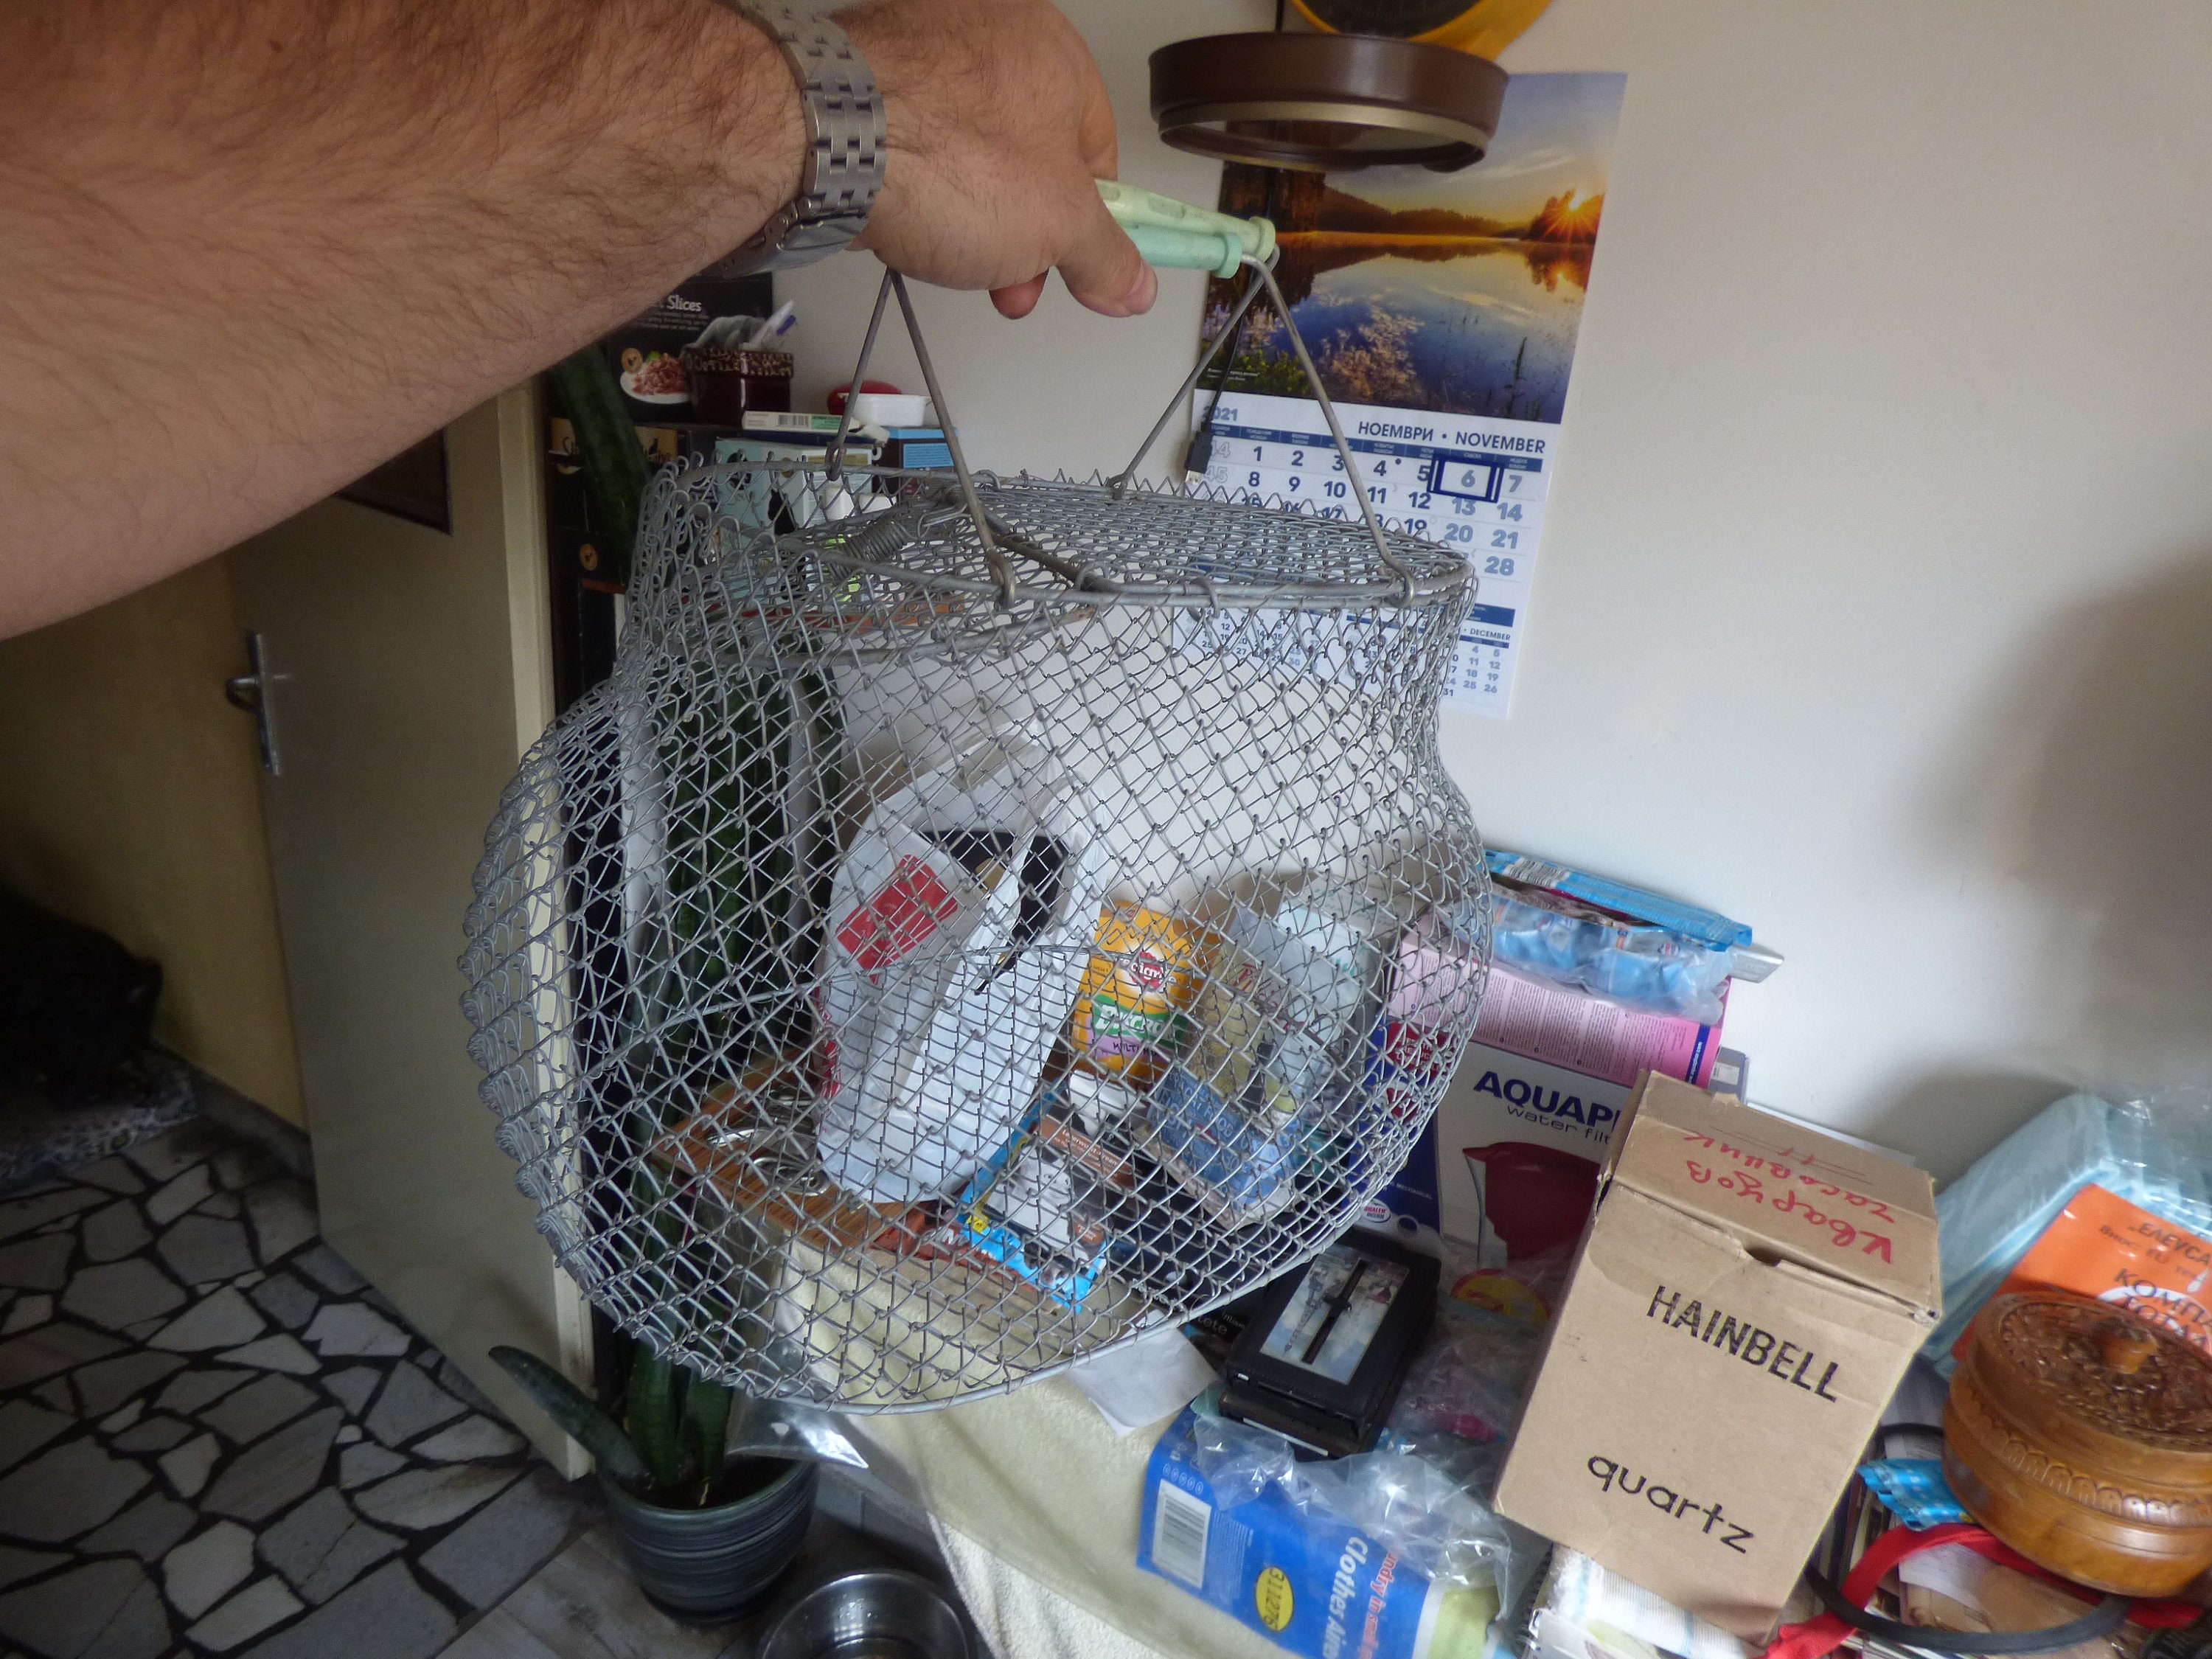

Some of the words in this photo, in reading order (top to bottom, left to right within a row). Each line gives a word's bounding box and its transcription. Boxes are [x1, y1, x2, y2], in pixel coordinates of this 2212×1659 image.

[667, 294, 702, 312] Slices
[1203, 406, 1239, 422] 021
[1357, 420, 1435, 442] НОЕМВРИ
[1454, 431, 1546, 454] NOVEMBER
[1253, 445, 1263, 462] 1
[1291, 450, 1304, 467] 2
[1332, 454, 1346, 471] 3
[1373, 459, 1387, 476] 4
[1417, 465, 1432, 481] 5
[1461, 469, 1475, 487] 6
[1509, 474, 1523, 493] 7
[1248, 471, 1261, 487] 8
[1288, 476, 1301, 493] 9
[1323, 481, 1347, 498] 10
[1367, 486, 1387, 504] 11
[1408, 491, 1432, 510] 12
[1452, 496, 1477, 516] 13
[1497, 502, 1523, 522] 14
[1404, 518, 1428, 535] 19
[1444, 522, 1474, 543] 20
[1490, 529, 1519, 550] 21
[1484, 555, 1515, 577] 28
[1220, 622, 1231, 631] 12
[1470, 627, 1512, 641] DECEMBER
[1236, 646, 1248, 655] 27
[1472, 645, 1479, 654] 4
[1469, 657, 1479, 667] 11
[1488, 661, 1501, 670] 12
[1465, 668, 1478, 678] 18
[1486, 672, 1499, 682] 19
[1463, 680, 1477, 689] 25
[1484, 684, 1498, 694] 26
[1507, 1105, 1578, 1133] water
[1646, 1285, 1839, 1403] HAINBELL
[1587, 1455, 1755, 1554] quartz
[1328, 1536, 1369, 1621] Clothes
[1368, 1595, 1386, 1613] in
